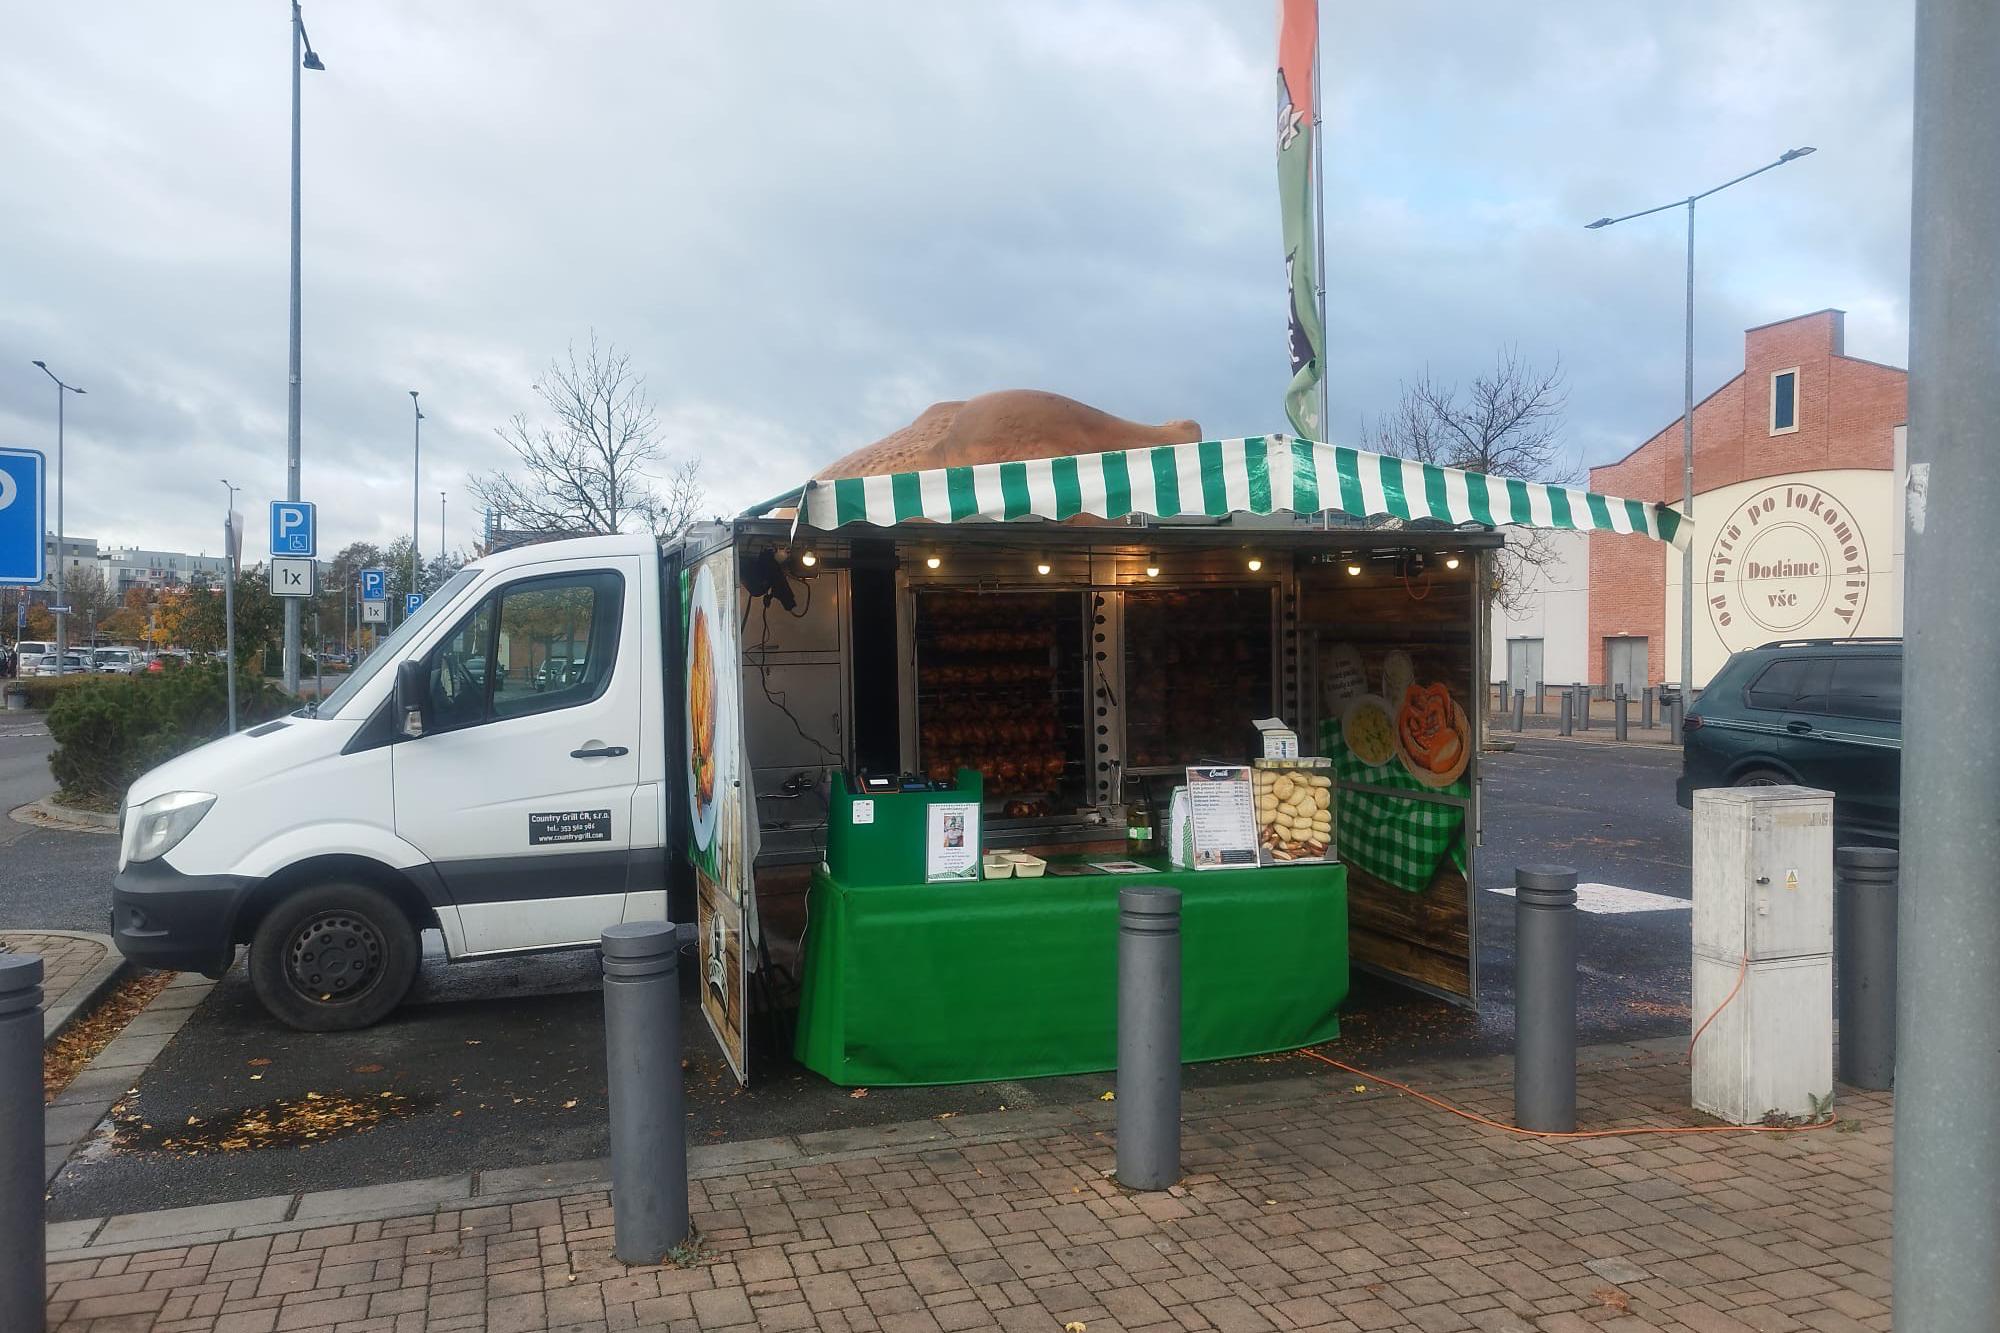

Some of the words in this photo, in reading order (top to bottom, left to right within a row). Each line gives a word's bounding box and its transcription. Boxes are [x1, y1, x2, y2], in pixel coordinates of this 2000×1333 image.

[280, 508, 303, 538] P
[1747, 497, 1776, 526] po
[1786, 487, 1866, 625] lokomotivy
[282, 568, 301, 585] 1x
[1748, 558, 1819, 579] Dodáme
[366, 573, 380, 591] P
[410, 596, 420, 608] P
[1767, 589, 1797, 607] vše
[531, 814, 561, 823] Country
[562, 813, 578, 821] Grill
